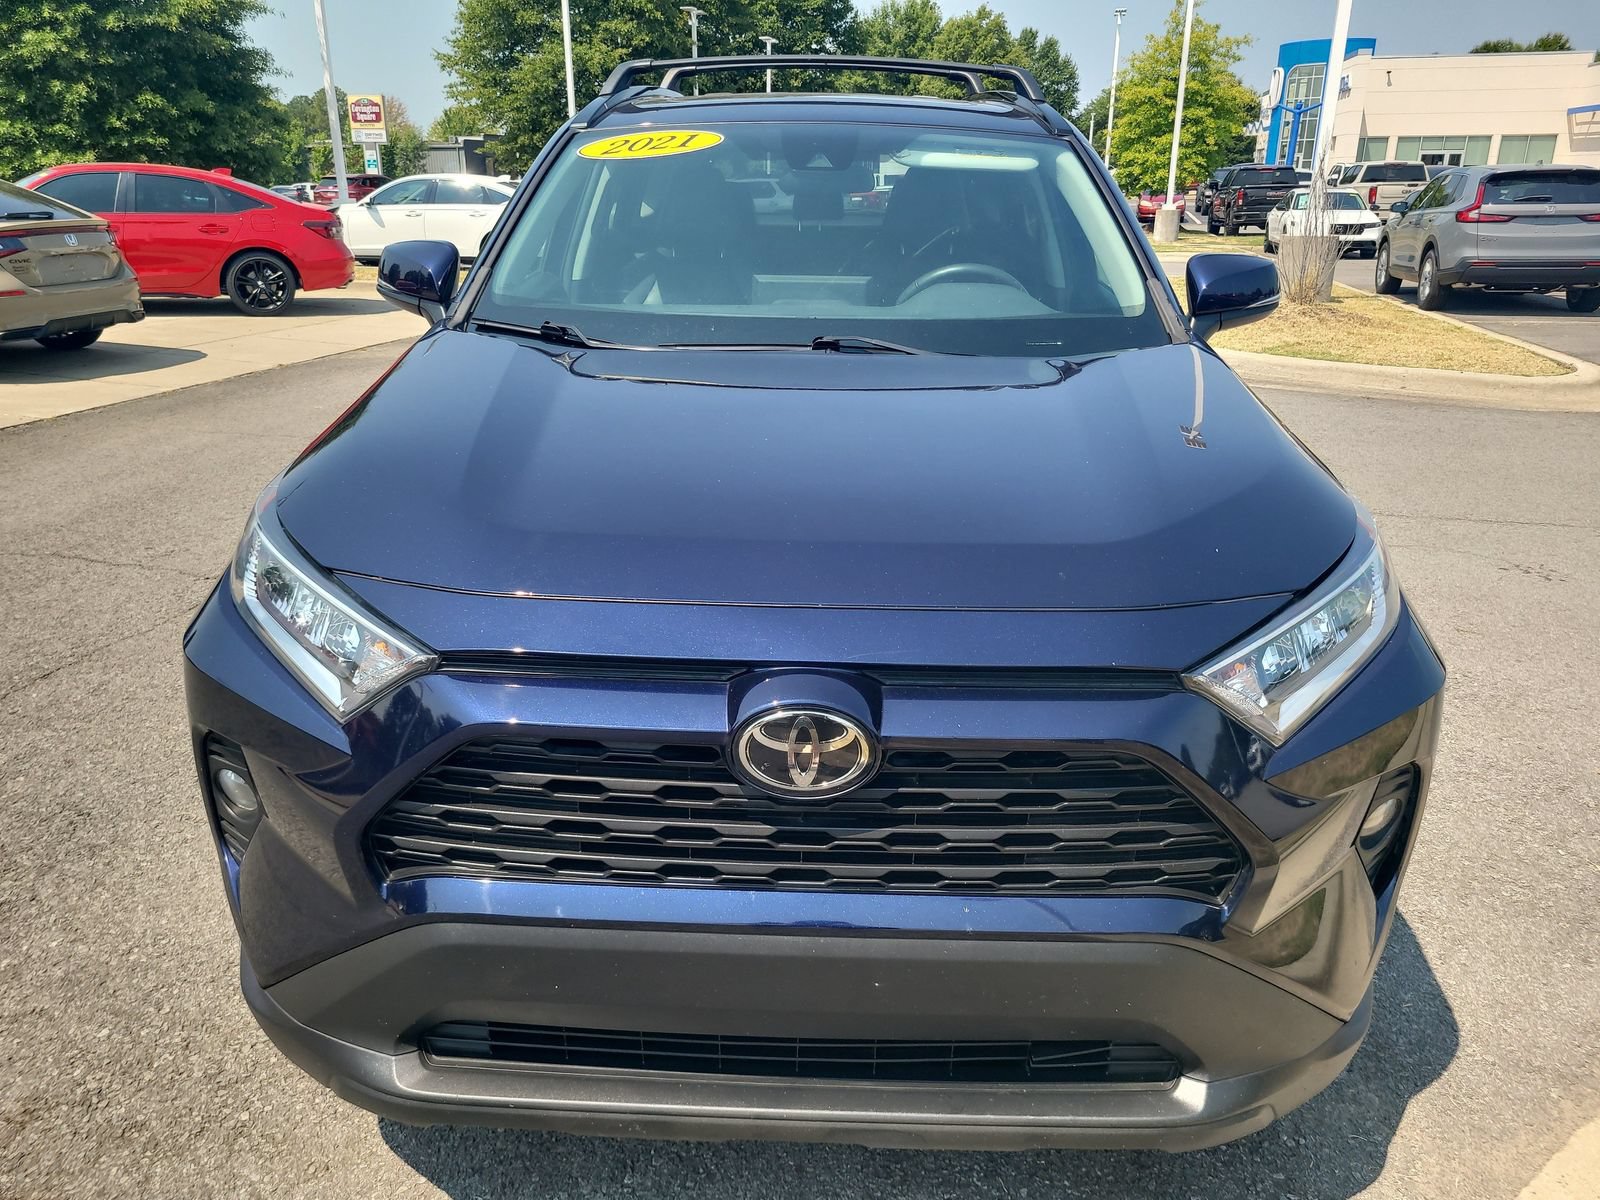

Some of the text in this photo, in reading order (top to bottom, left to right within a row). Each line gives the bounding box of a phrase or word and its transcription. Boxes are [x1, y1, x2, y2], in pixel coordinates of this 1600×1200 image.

[351, 103, 380, 115] Covington
[356, 112, 377, 122] Square
[600, 134, 699, 155] 2021
